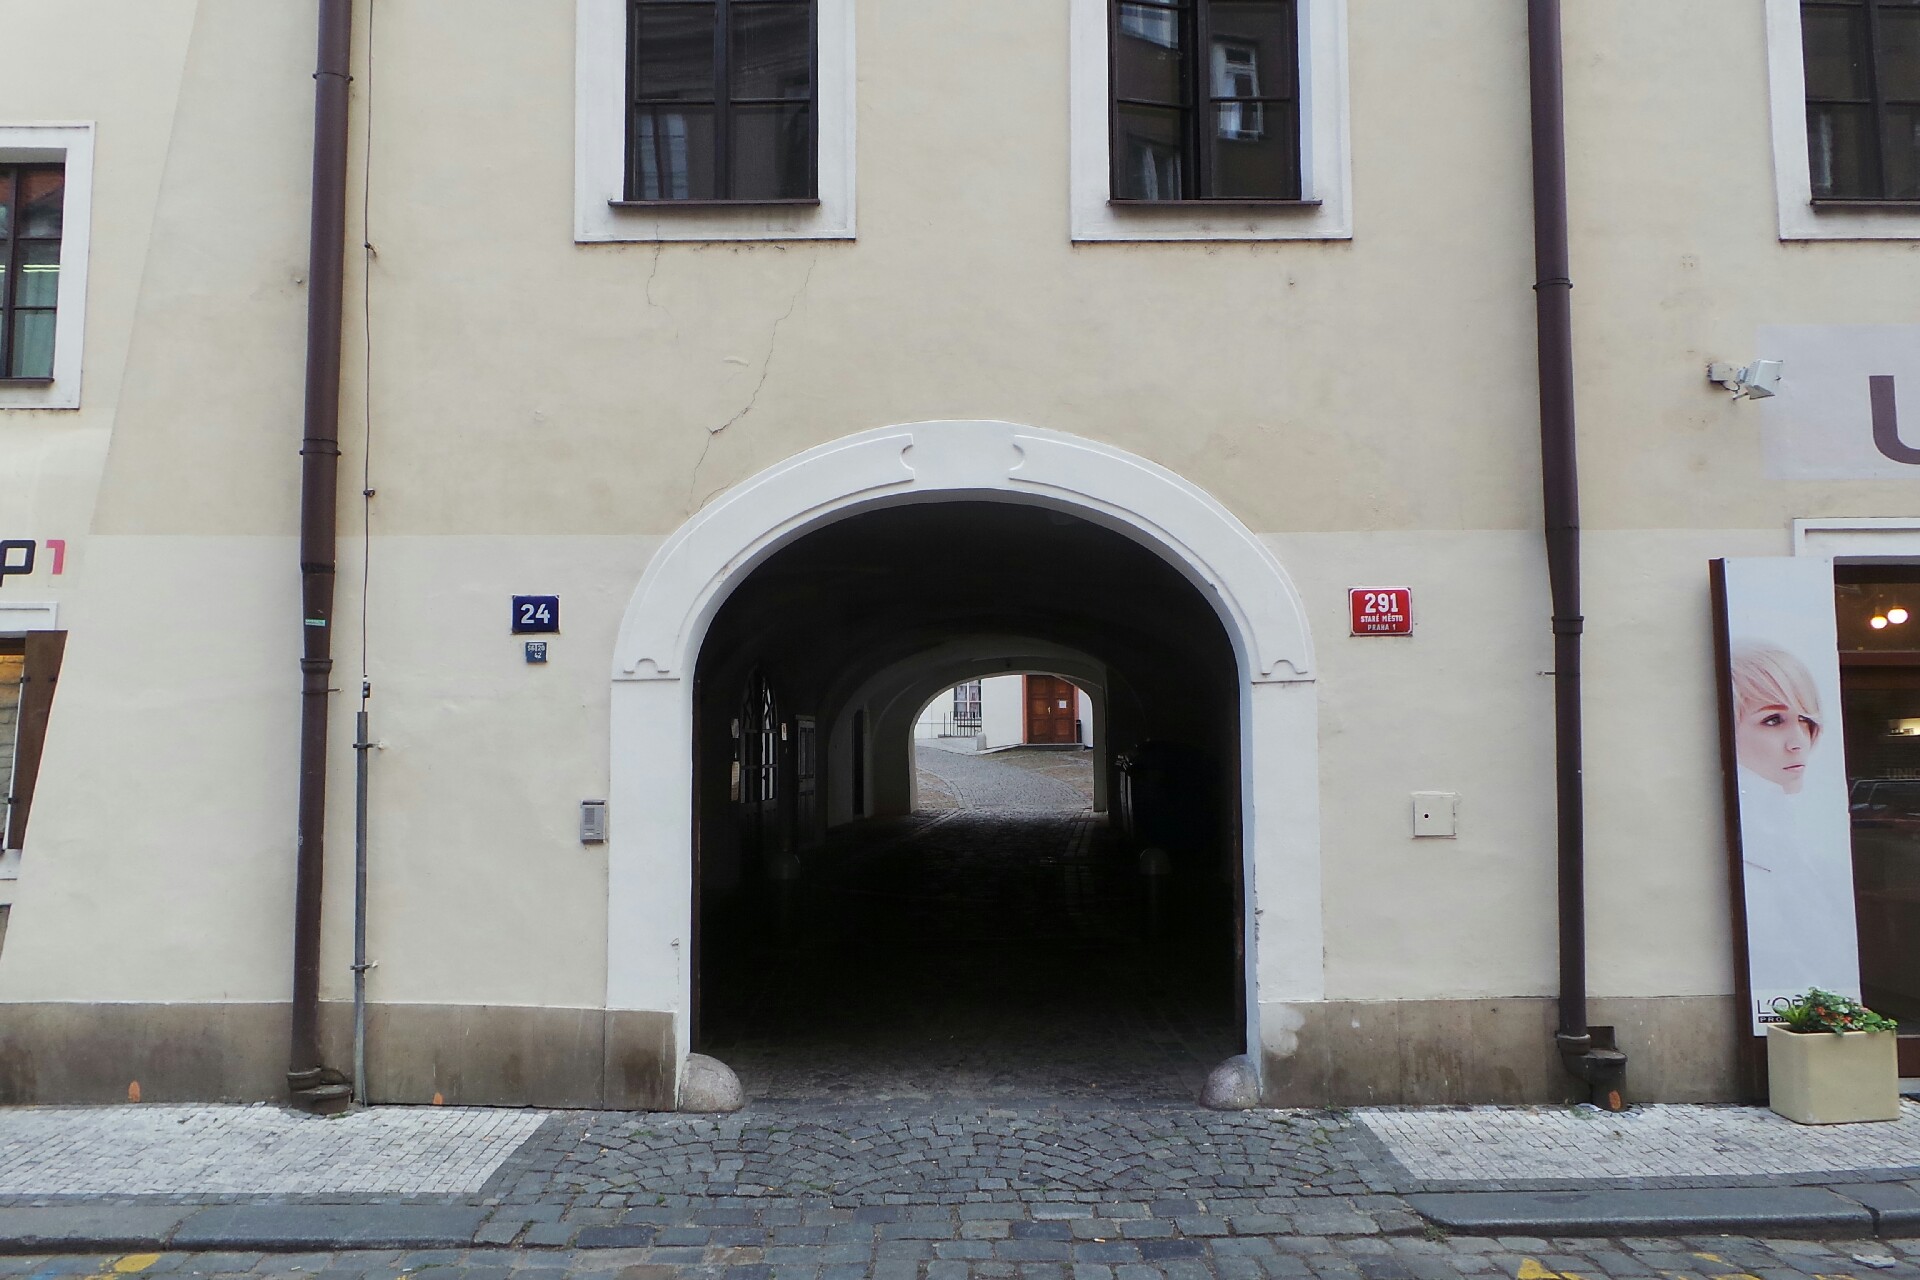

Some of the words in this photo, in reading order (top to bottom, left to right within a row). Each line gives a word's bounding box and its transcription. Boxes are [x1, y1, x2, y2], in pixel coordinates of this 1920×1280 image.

[1364, 592, 1399, 614] 291
[520, 603, 551, 624] 24
[1360, 614, 1380, 623] STARÉ
[1367, 623, 1390, 631] PRAHA
[1392, 623, 1397, 631] 1
